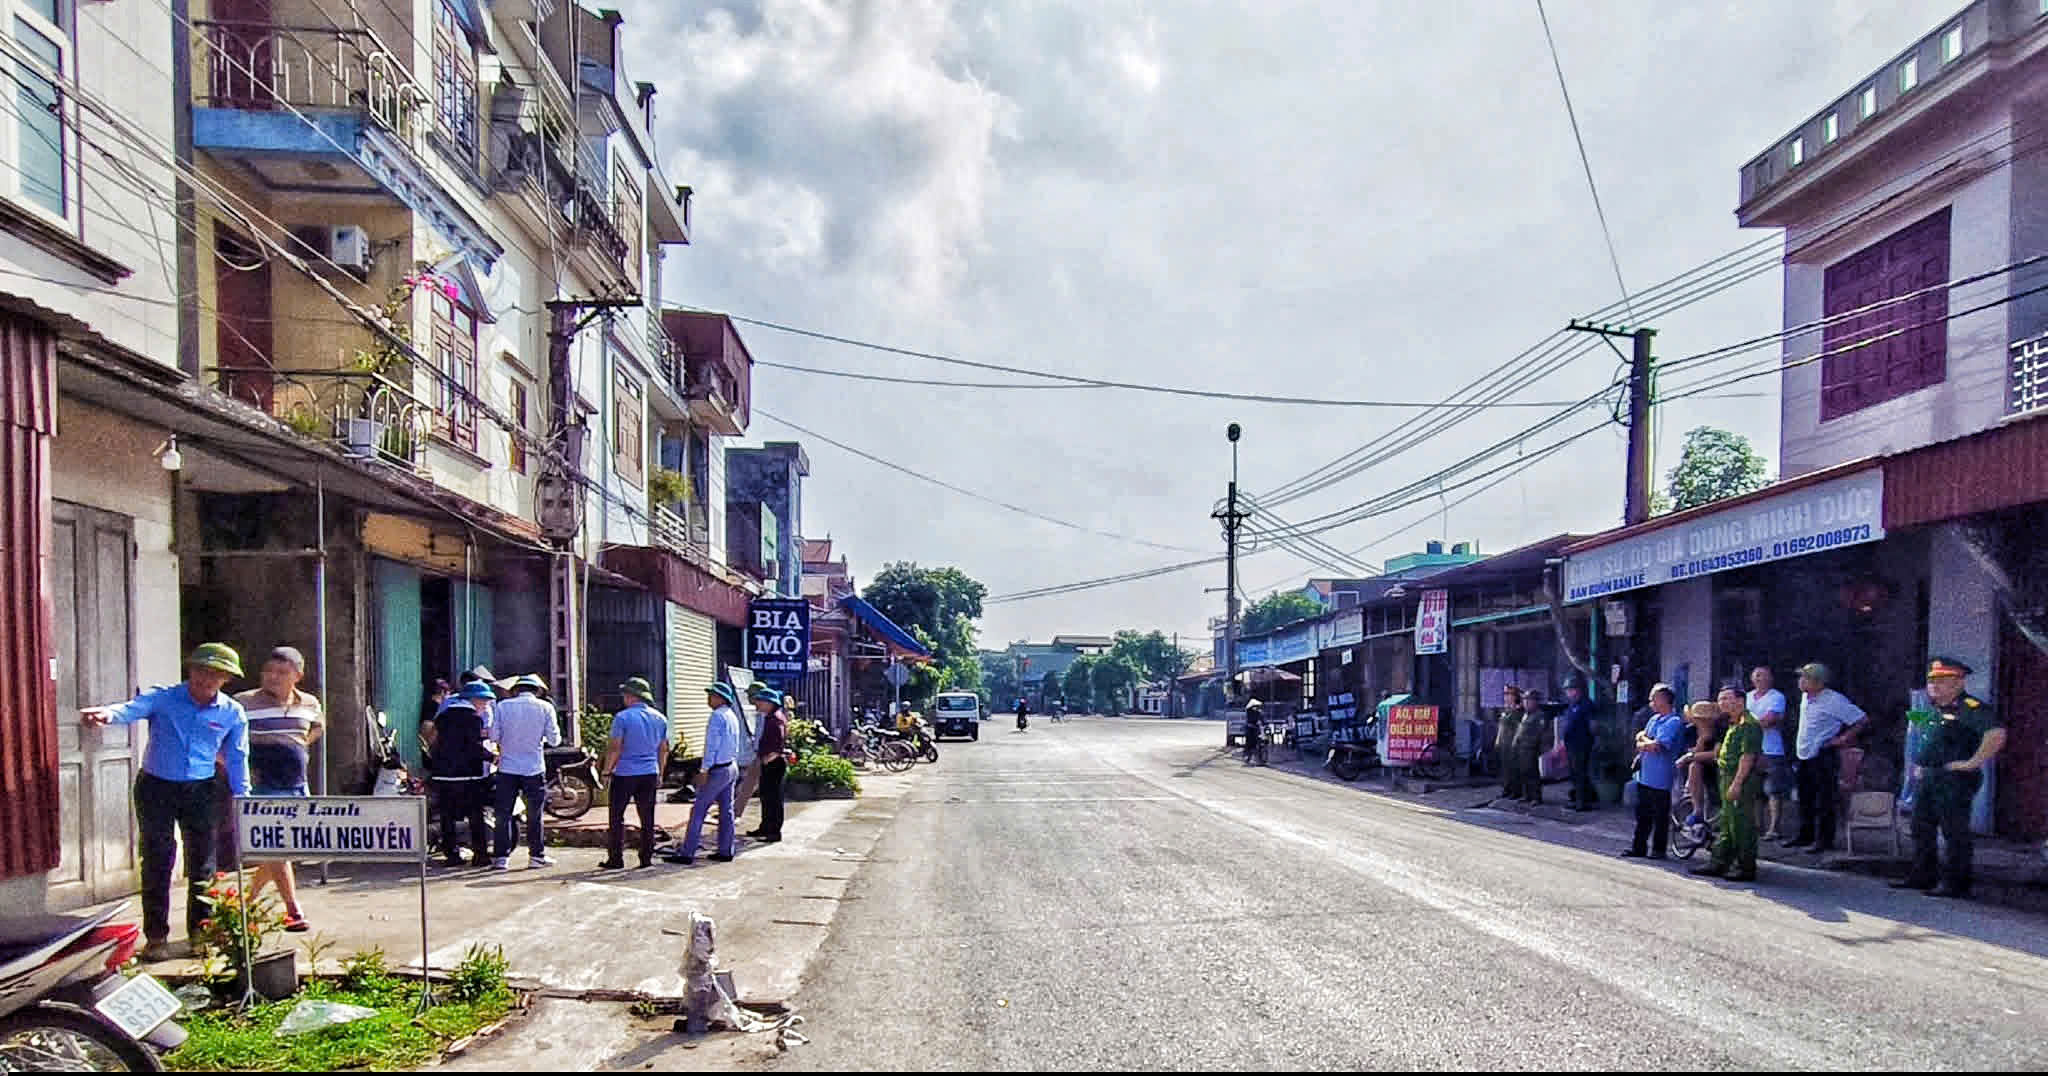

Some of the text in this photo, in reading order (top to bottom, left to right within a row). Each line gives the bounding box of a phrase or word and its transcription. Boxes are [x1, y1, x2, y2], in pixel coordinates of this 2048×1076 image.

[751, 609, 804, 630] BIA
[754, 629, 802, 661] MỘ
[249, 820, 413, 850] CHÈ THÁI NGUYÊN
